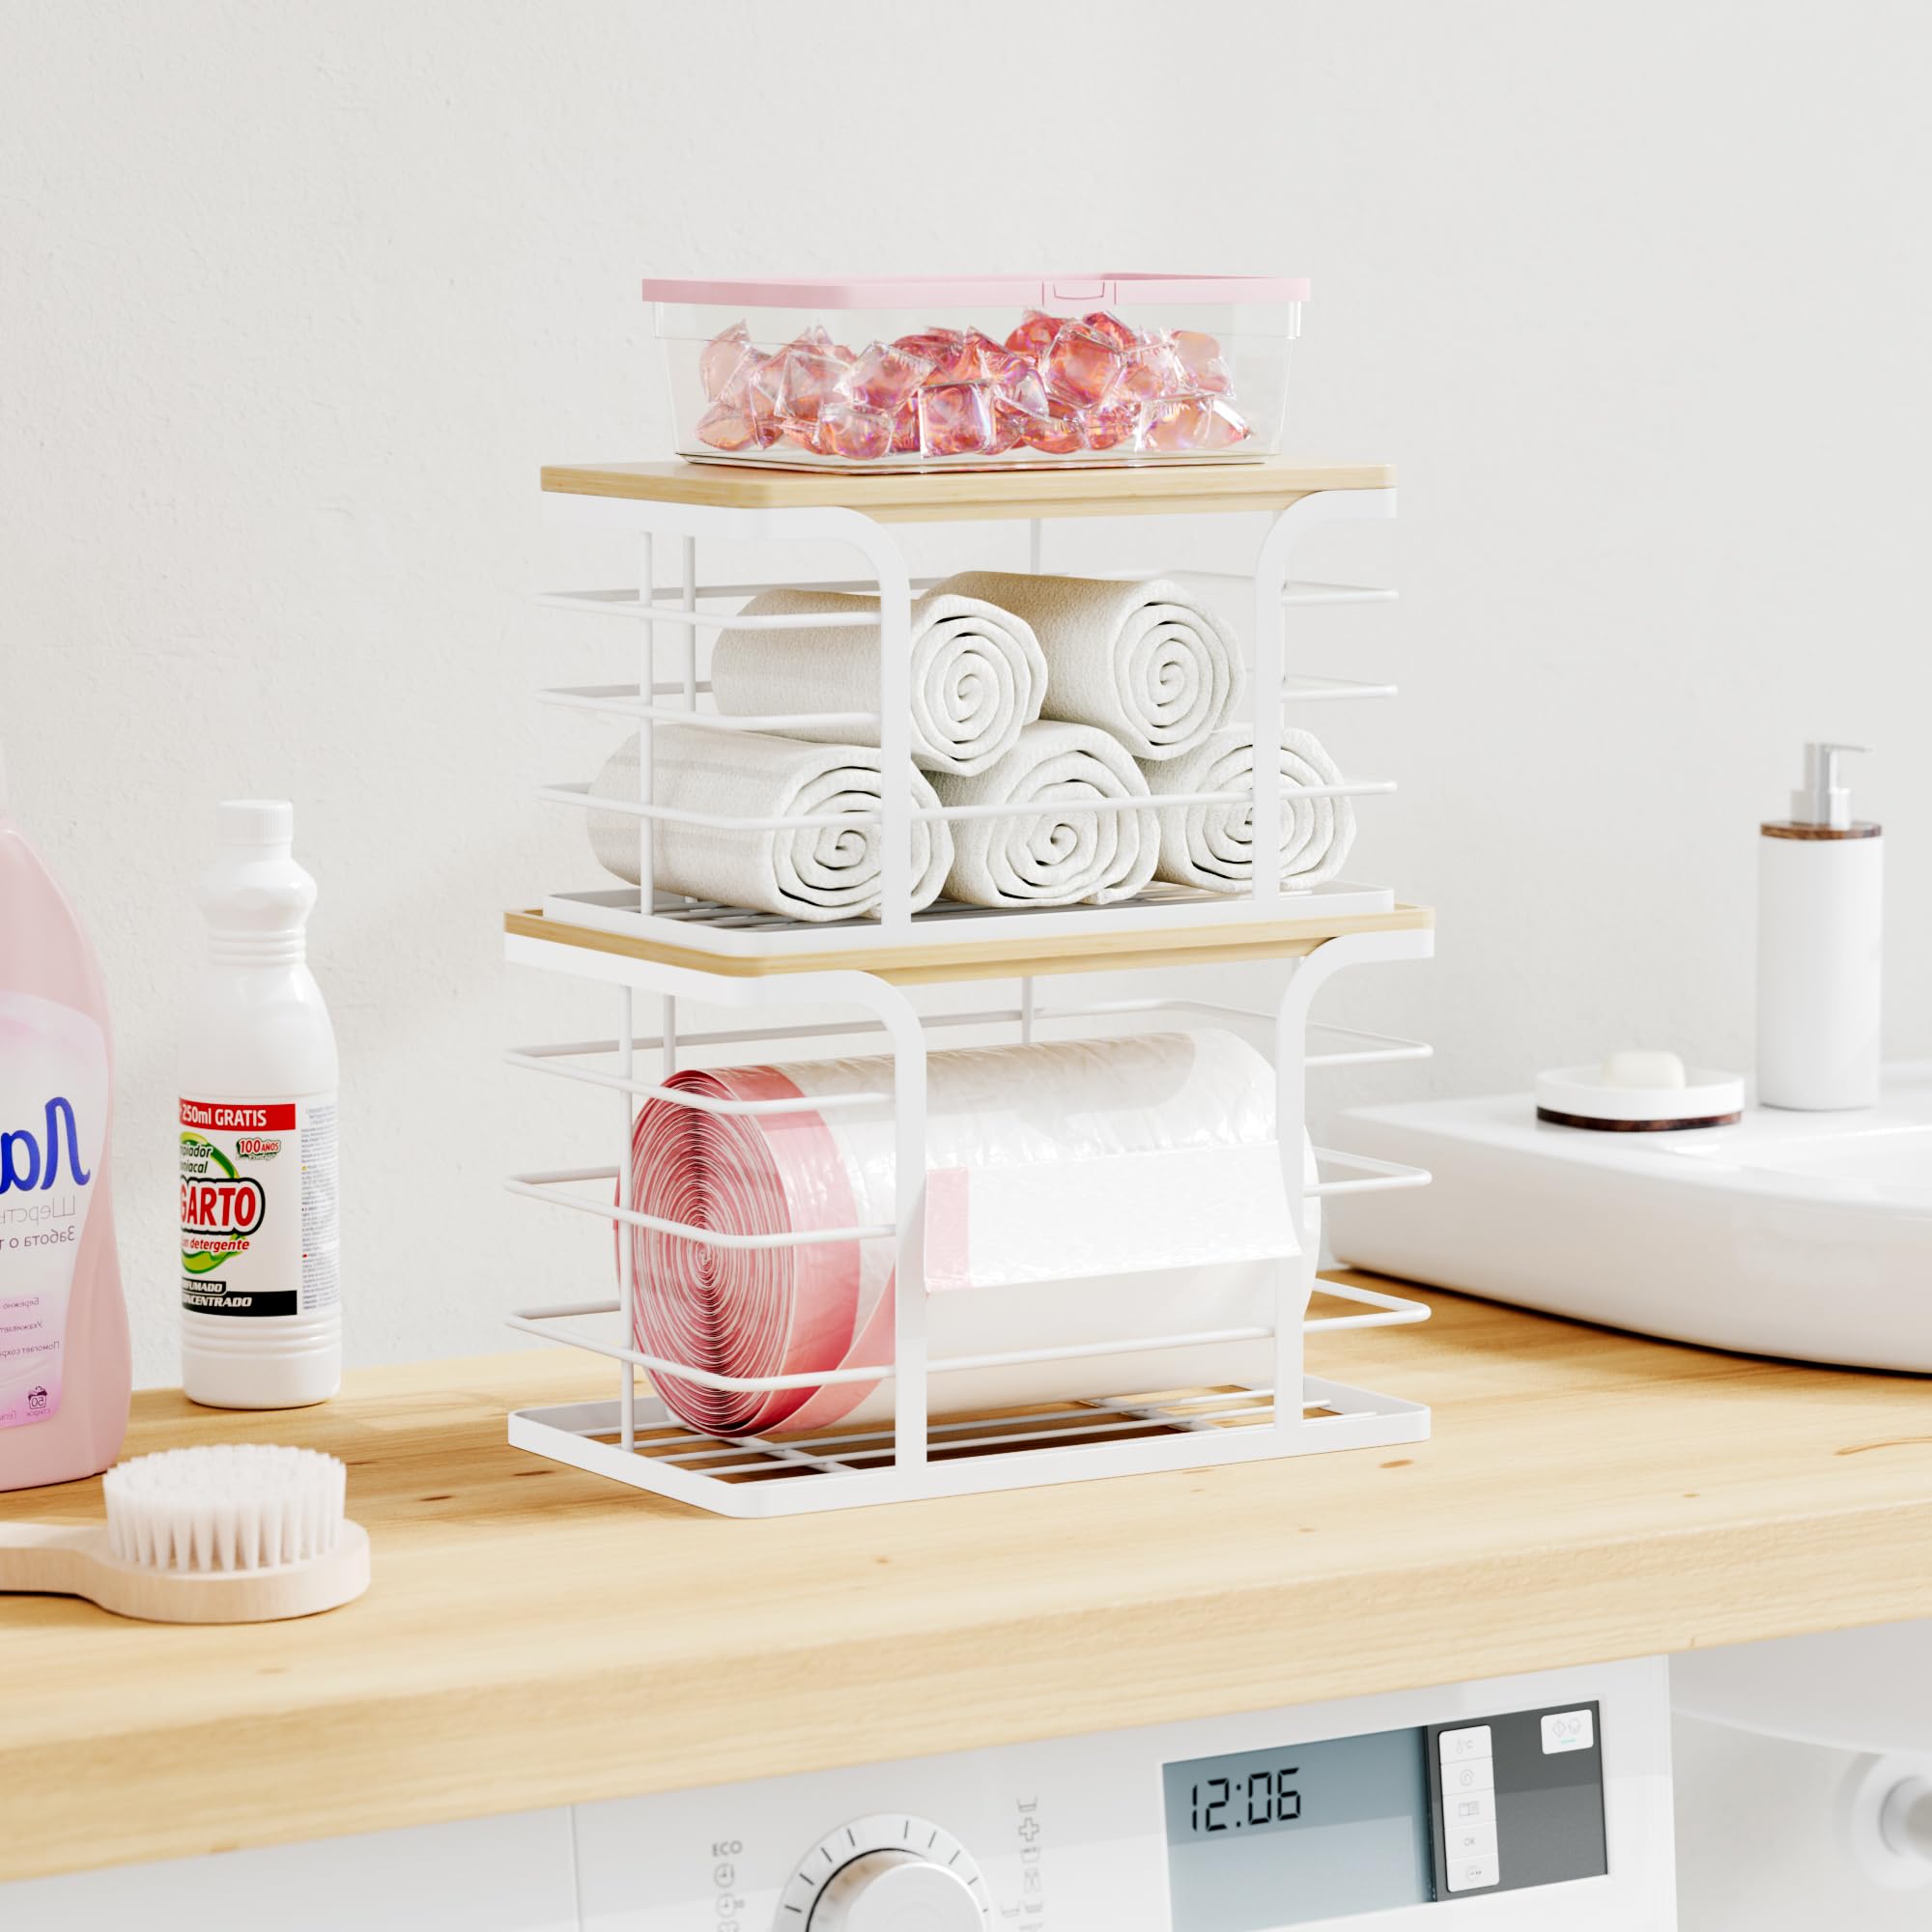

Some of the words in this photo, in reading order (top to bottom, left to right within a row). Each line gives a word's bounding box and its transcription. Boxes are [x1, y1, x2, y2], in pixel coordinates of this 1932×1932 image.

[214, 1108, 267, 1127] GRATIS
[241, 1140, 261, 1153] 100
[190, 1237, 250, 1252] detergente
[1191, 1767, 1301, 1833] 12:06
[711, 1839, 743, 1857] ECO
